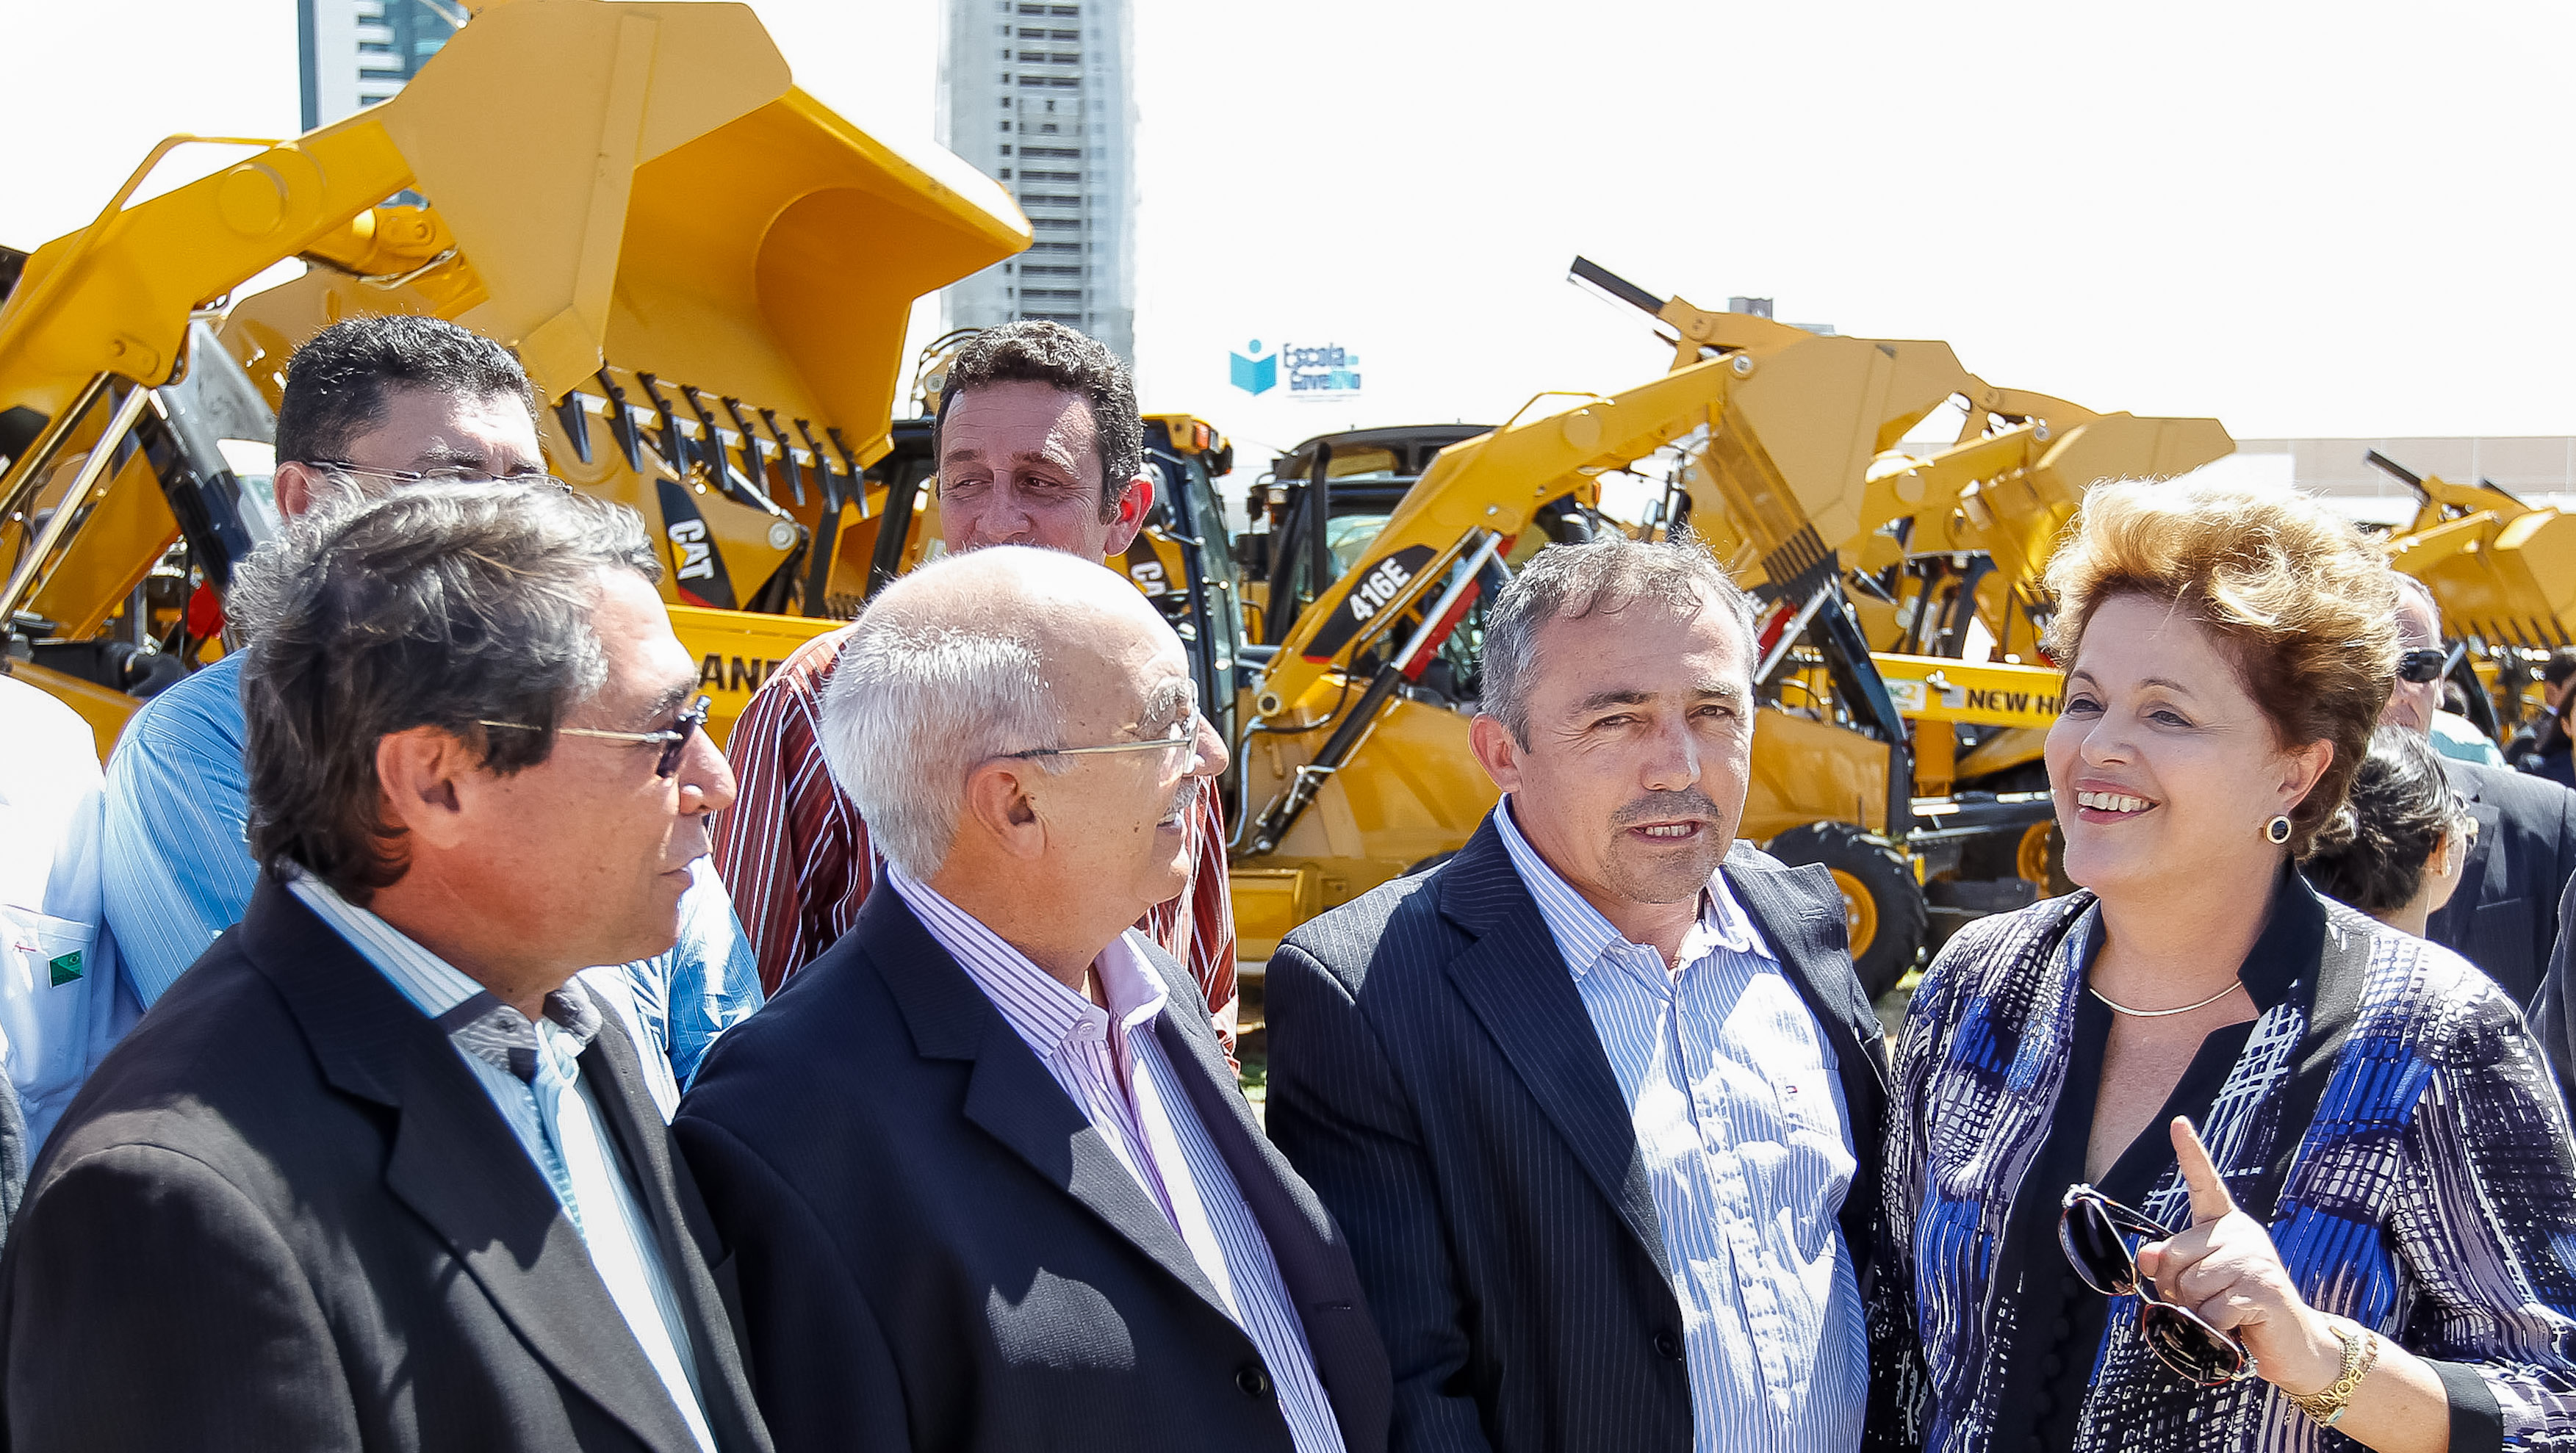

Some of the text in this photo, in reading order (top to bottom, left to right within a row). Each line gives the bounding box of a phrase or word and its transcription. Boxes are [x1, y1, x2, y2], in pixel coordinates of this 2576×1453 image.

[668, 519, 714, 580] CAT
[1131, 560, 1168, 598] CA
[1349, 558, 1411, 621] 416E
[1967, 688, 2029, 713] NEW
